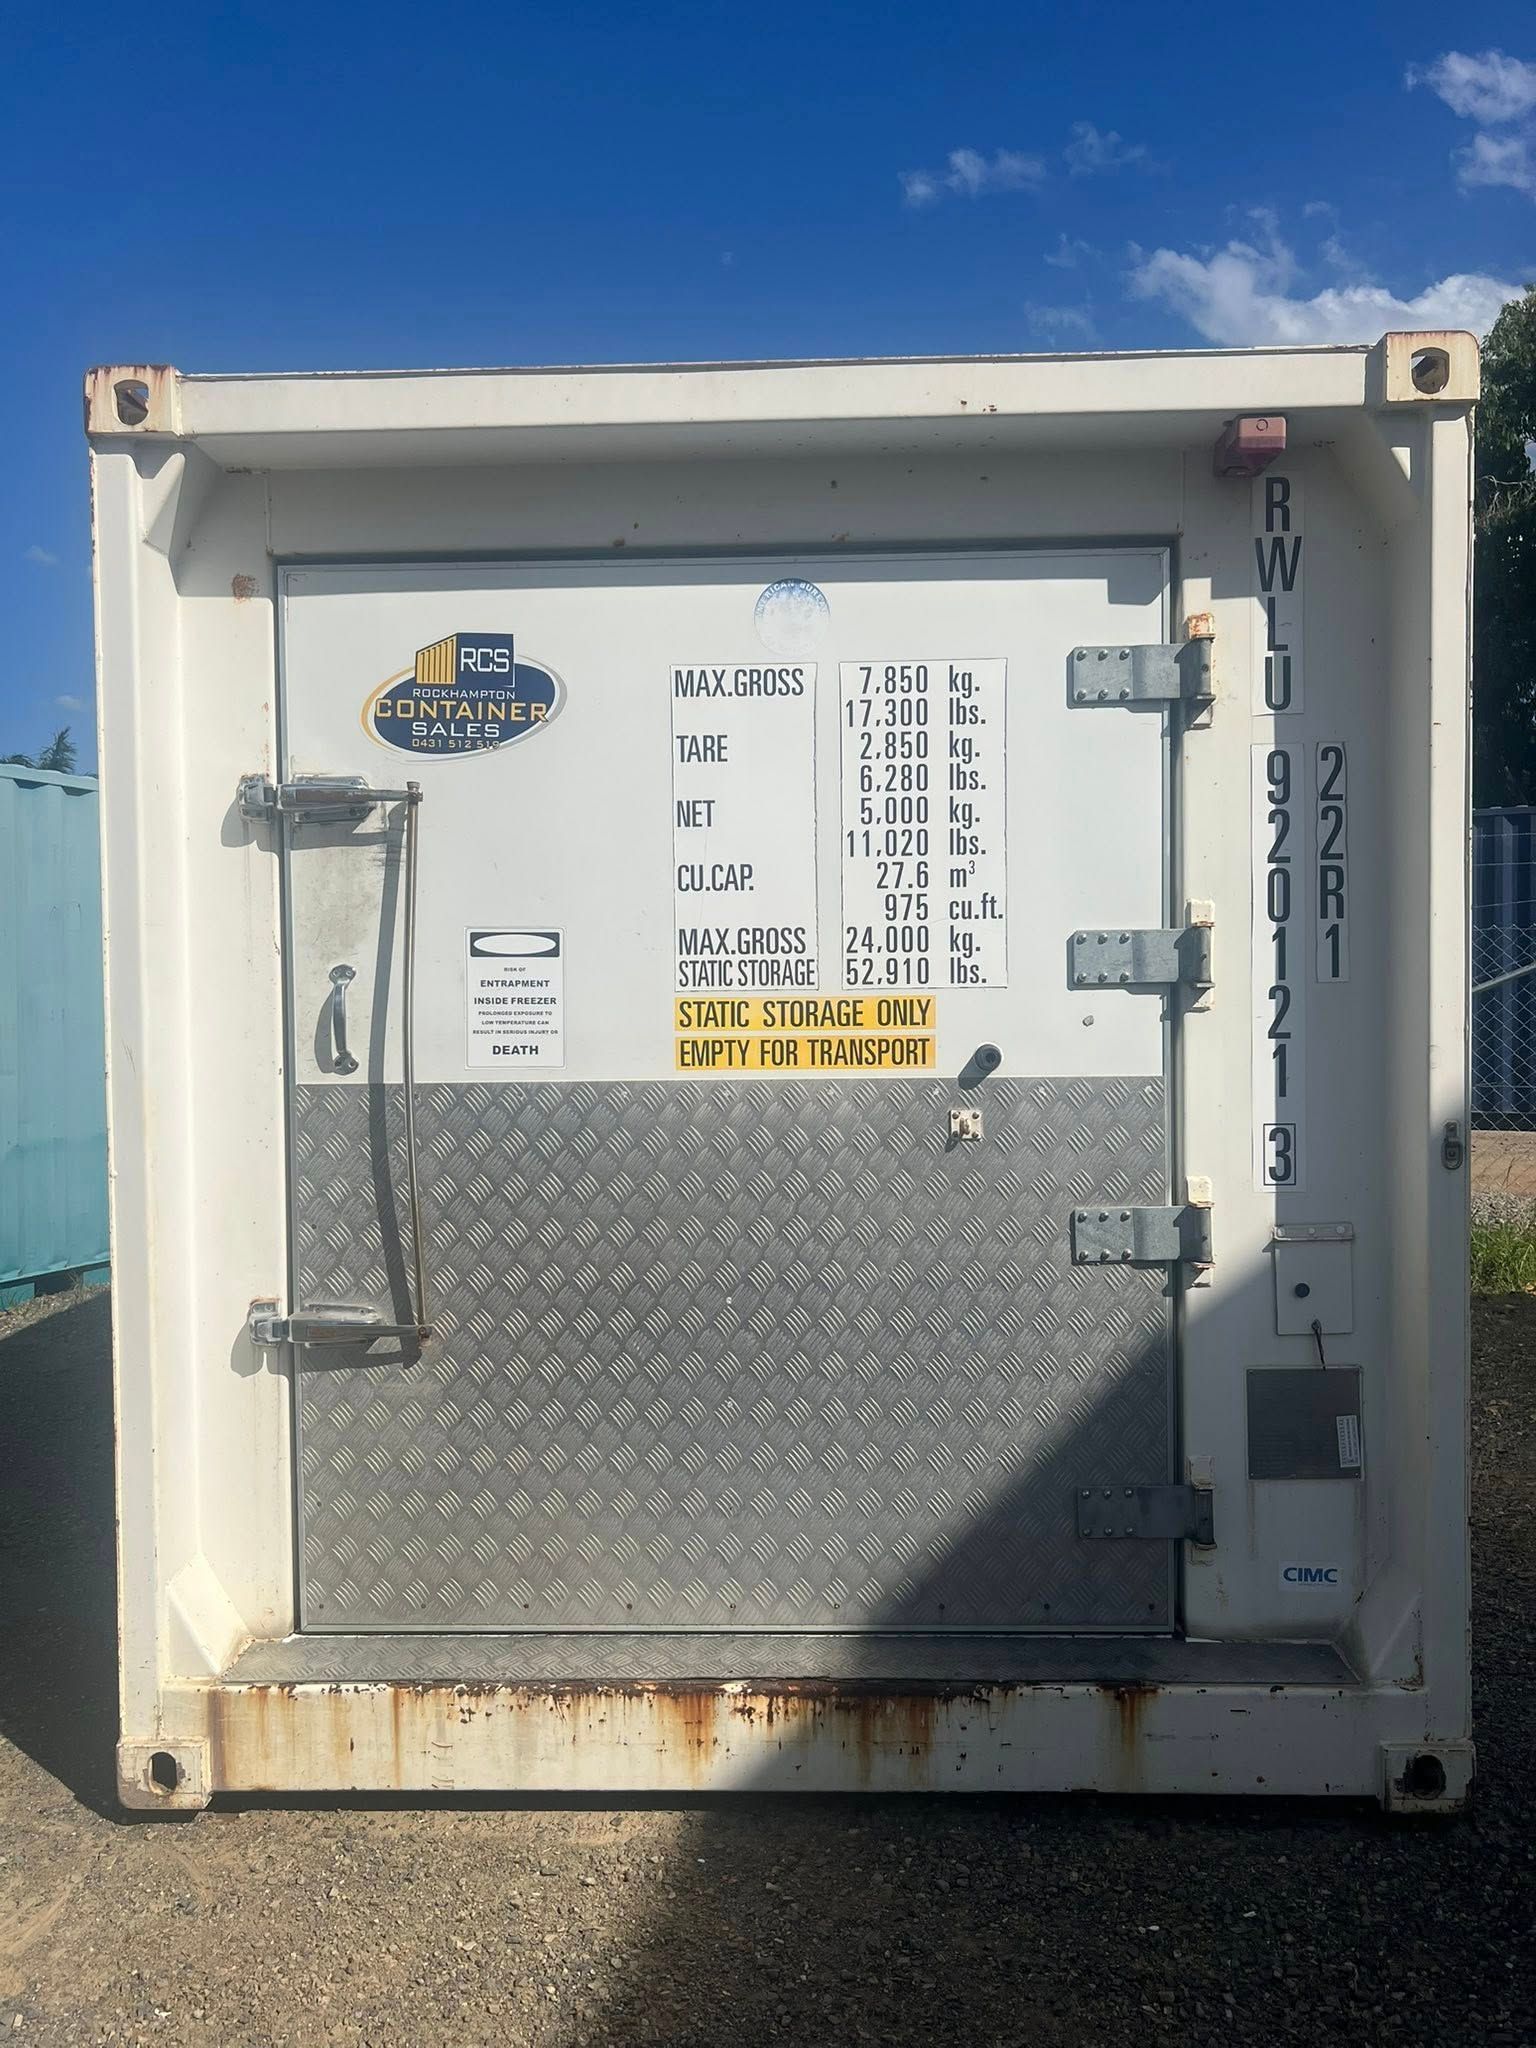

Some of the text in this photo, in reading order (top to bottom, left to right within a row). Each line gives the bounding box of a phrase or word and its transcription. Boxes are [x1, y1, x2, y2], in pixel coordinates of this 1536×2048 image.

[460, 647, 510, 673] RCS
[412, 688, 516, 700] ROCKHAMPTON
[674, 668, 805, 697] MAX.GROSS
[859, 664, 980, 698] 7,850 kg.
[375, 698, 549, 722] CONTAINER
[845, 697, 987, 729] 17,300 lbs.
[412, 722, 500, 737] SALES
[412, 738, 443, 747] 0431
[448, 739, 472, 749] 512
[676, 734, 729, 763] TARE
[859, 731, 980, 765] 2,850 kg.
[859, 763, 987, 794] 6,280 lbs.
[676, 799, 715, 827] NET
[859, 796, 980, 830] 5,000 kg.
[846, 828, 987, 858] 11,020 lbs.
[1255, 476, 1302, 1183] RWLU 920121 3
[876, 862, 929, 890] 27.6
[1319, 745, 1344, 979] 22R1
[677, 864, 755, 892] CU.CAP.
[884, 894, 1004, 921] 975 cu.ft.
[679, 927, 807, 956] MAX.GROSS
[846, 926, 981, 958] 24,000 kg.
[480, 980, 550, 988] ENTRAPMENT
[679, 959, 815, 987] STATIC STORAGE
[846, 958, 987, 986] 52,910 lbs.
[473, 997, 557, 1005] INSIDE FREEZER
[679, 998, 931, 1028] STATIC STORAGE ONLY
[492, 1045, 539, 1055] DEATH
[680, 1038, 931, 1067] EMPTY FOR TRANSPORT
[1283, 1567, 1338, 1583] CIMC
